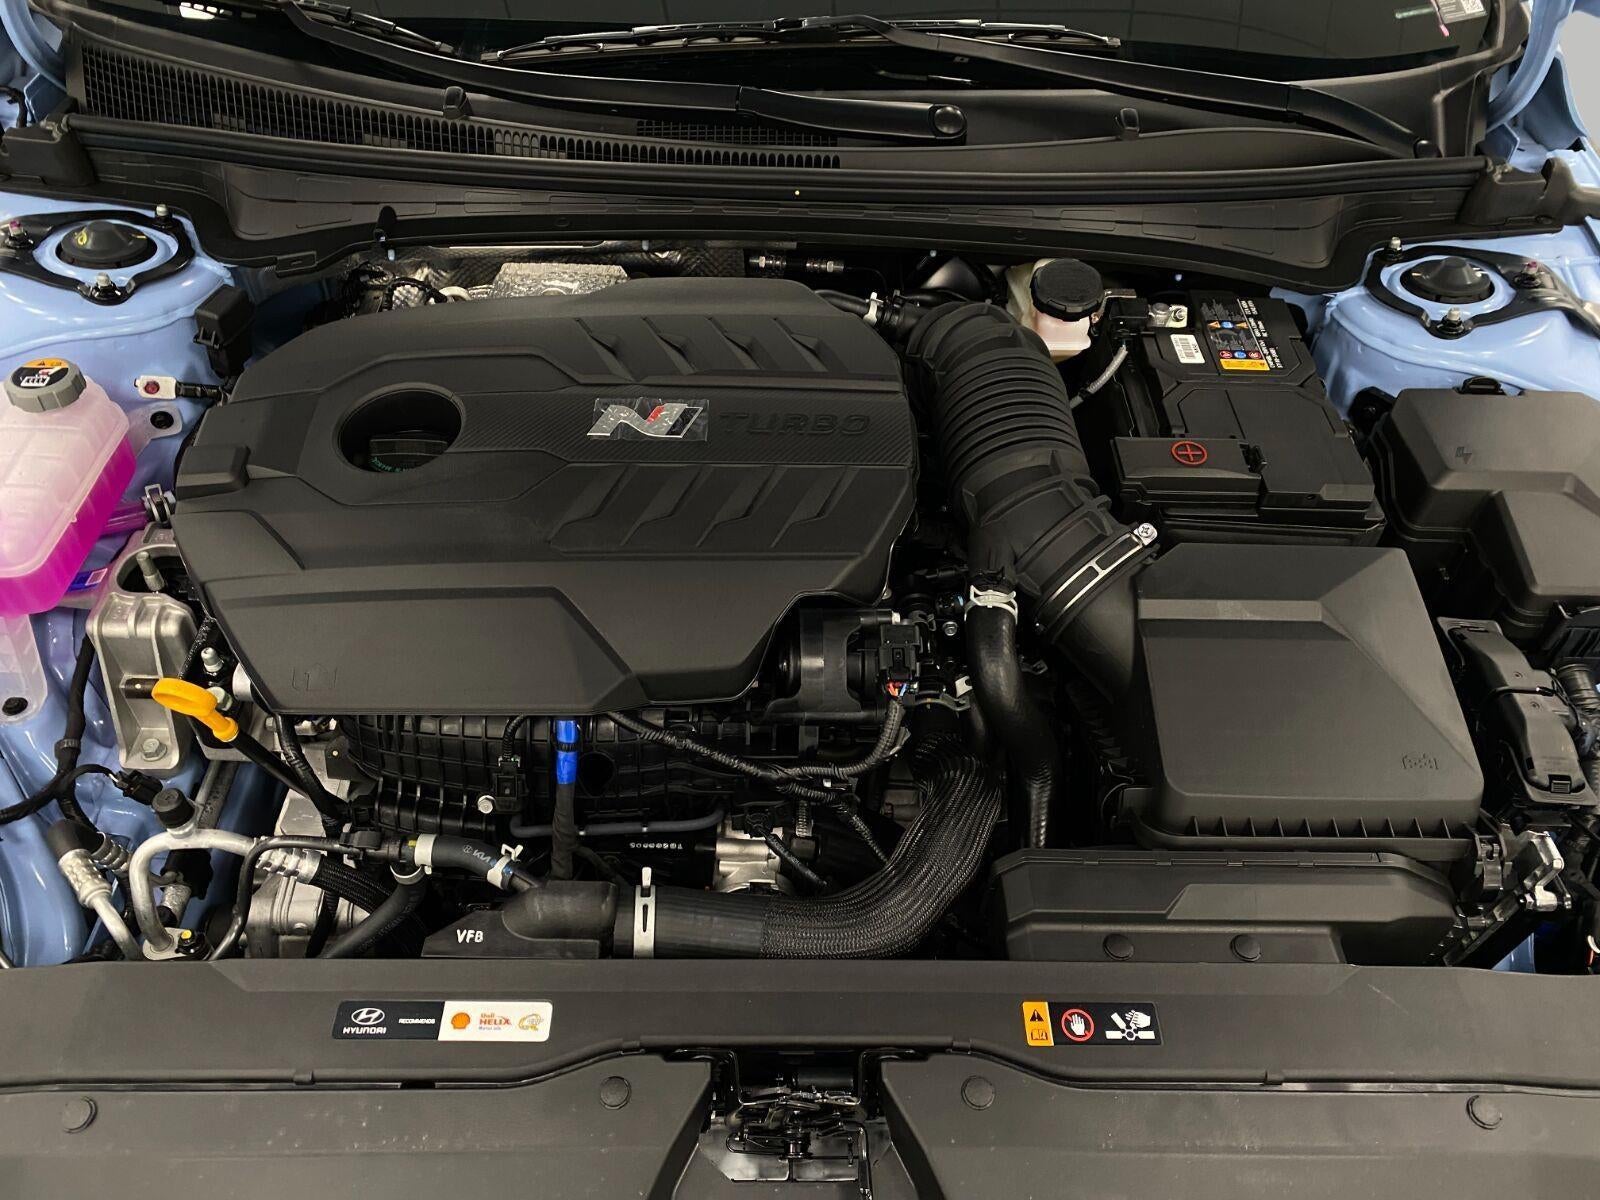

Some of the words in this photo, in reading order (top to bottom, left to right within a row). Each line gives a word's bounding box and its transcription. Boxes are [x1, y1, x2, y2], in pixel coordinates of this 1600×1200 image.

[718, 411, 871, 435] TURBO
[472, 848, 492, 863] KIA
[479, 1017, 512, 1026] HELIX
[342, 1026, 387, 1034] HYUNDAI
